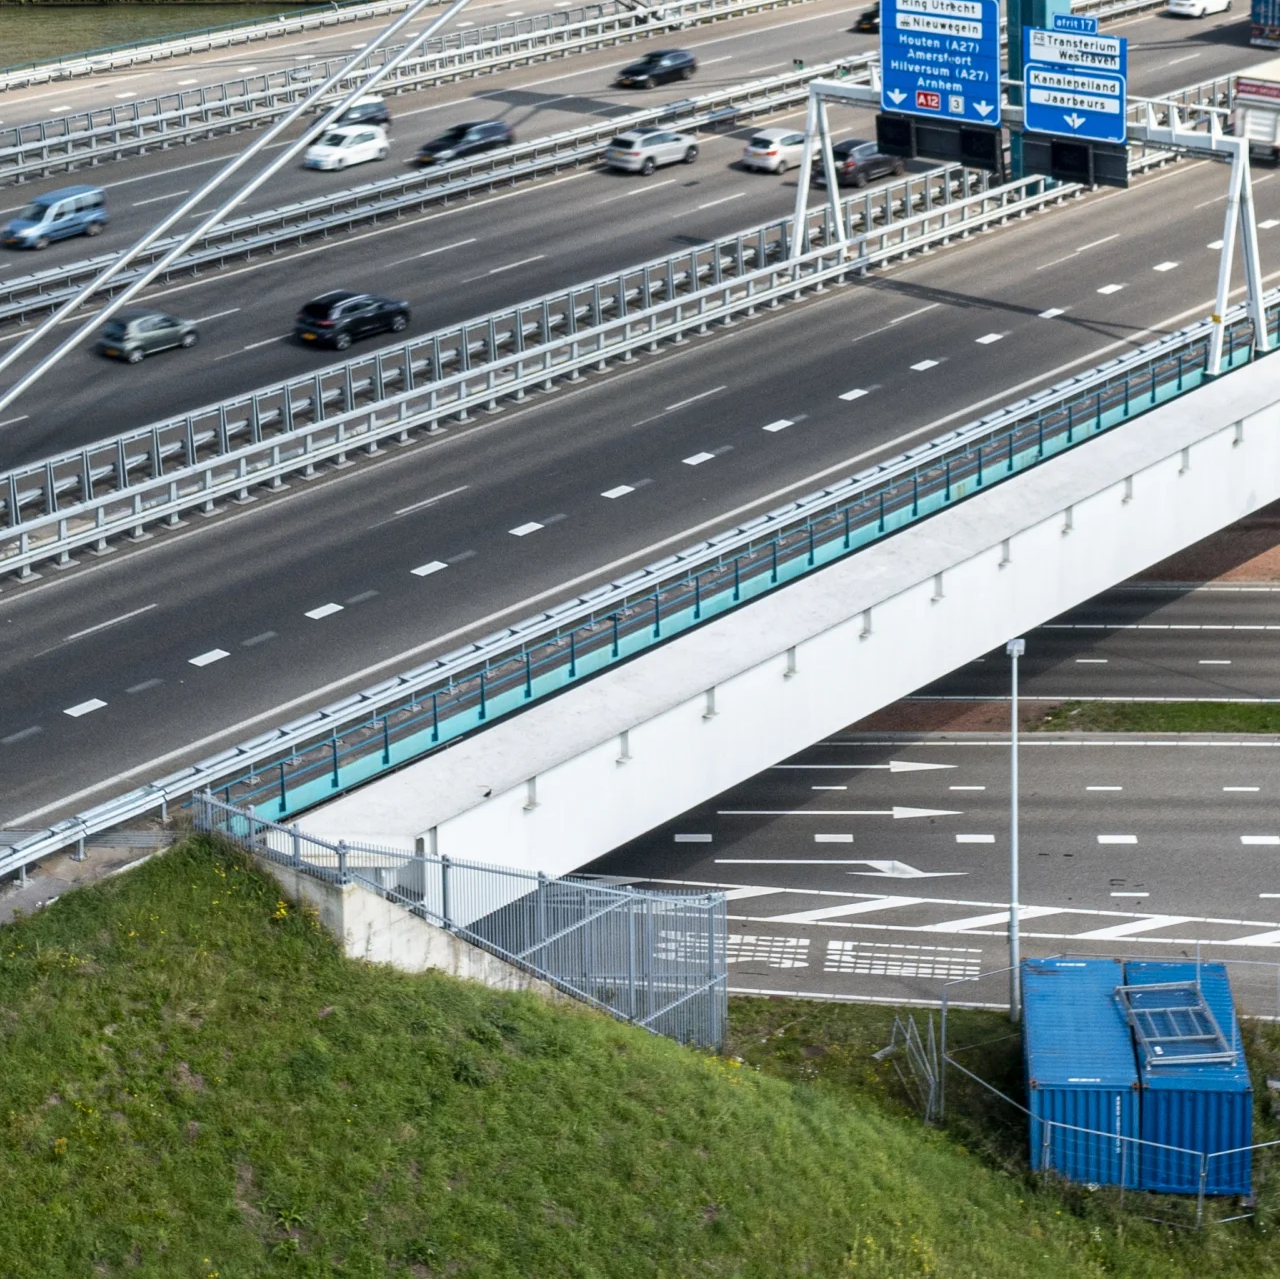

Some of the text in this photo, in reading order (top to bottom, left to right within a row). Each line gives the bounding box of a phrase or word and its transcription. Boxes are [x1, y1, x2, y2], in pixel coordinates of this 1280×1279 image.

[932, 0, 977, 14] Utrecht
[913, 17, 979, 34] Nieuwegein
[1056, 18, 1093, 31] afrit 17
[899, 34, 980, 53] Houten (A27)
[1047, 35, 1117, 53] Transferium
[1059, 50, 1117, 67] Westraven
[890, 59, 989, 82] Hilversum (A27)
[917, 77, 963, 92] Arnhem
[918, 94, 939, 108] A12
[953, 100, 960, 109] 3
[1044, 94, 1106, 110] Jaarbeurs
